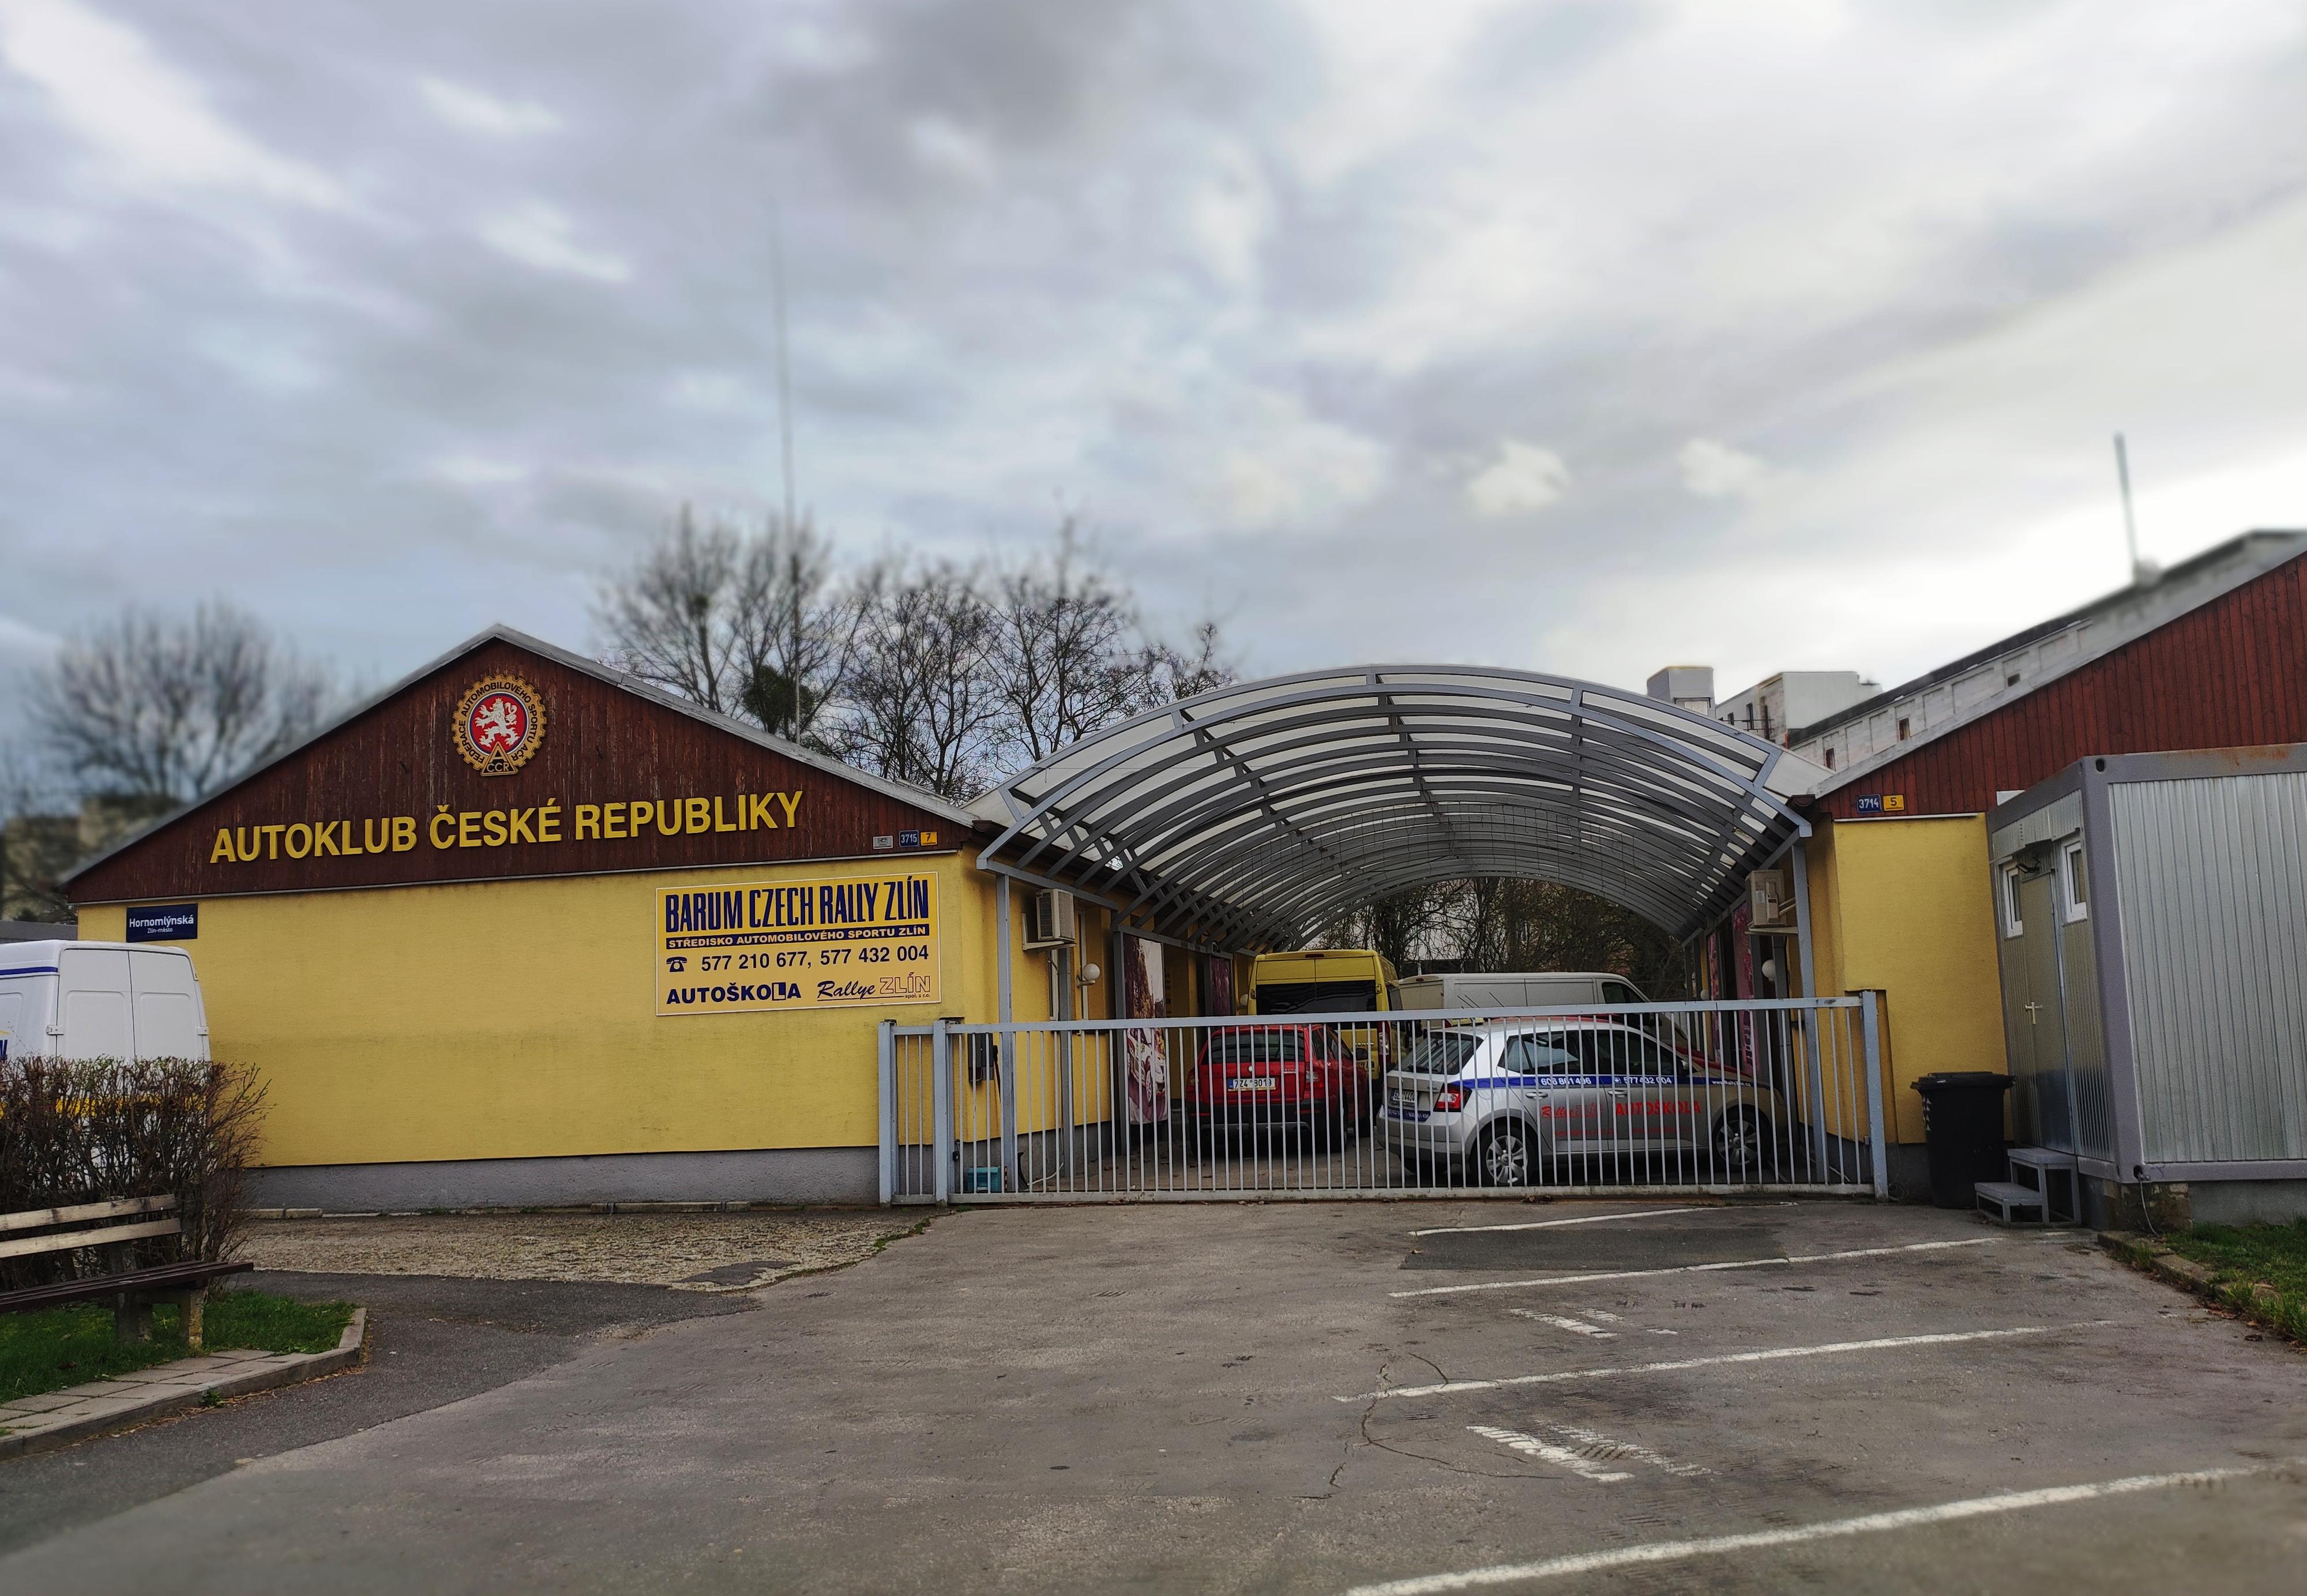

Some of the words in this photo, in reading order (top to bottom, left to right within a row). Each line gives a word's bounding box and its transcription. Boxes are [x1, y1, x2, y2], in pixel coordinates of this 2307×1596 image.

[461, 682, 531, 717] AUTOMOBILOVÉHO
[527, 703, 538, 744] SPORTU
[459, 720, 485, 763] FEDERACE
[1858, 797, 1879, 809] 3714
[1890, 797, 1897, 807] 5
[209, 816, 417, 864] AUTOKLUB
[429, 798, 562, 850] ČESKÉ
[576, 791, 803, 840] REPUBLIKY
[900, 833, 918, 844] 3715
[926, 833, 931, 842] 7
[666, 890, 743, 933] BARUM
[749, 886, 814, 928] CZECH
[820, 882, 879, 925] RALLY
[884, 876, 929, 921] ZLÍN
[129, 914, 194, 928] Hornomlýnská
[669, 937, 733, 948] STŘEDISKO
[737, 931, 844, 944] AUTOMOBILOVÉHO
[848, 928, 895, 939] SPORTU
[899, 925, 926, 936] ZLÍN
[701, 955, 732, 972] 577
[738, 953, 770, 969] 210
[776, 951, 811, 969] 677,
[820, 948, 852, 965] 577
[858, 947, 890, 962] 432
[897, 944, 929, 961] 004
[666, 983, 802, 1004] AUTOŠKOLA
[817, 980, 876, 1000] Rallye
[880, 972, 931, 994] ZLÍN
[1615, 1099, 1701, 1116] AUTOŠKOLA
